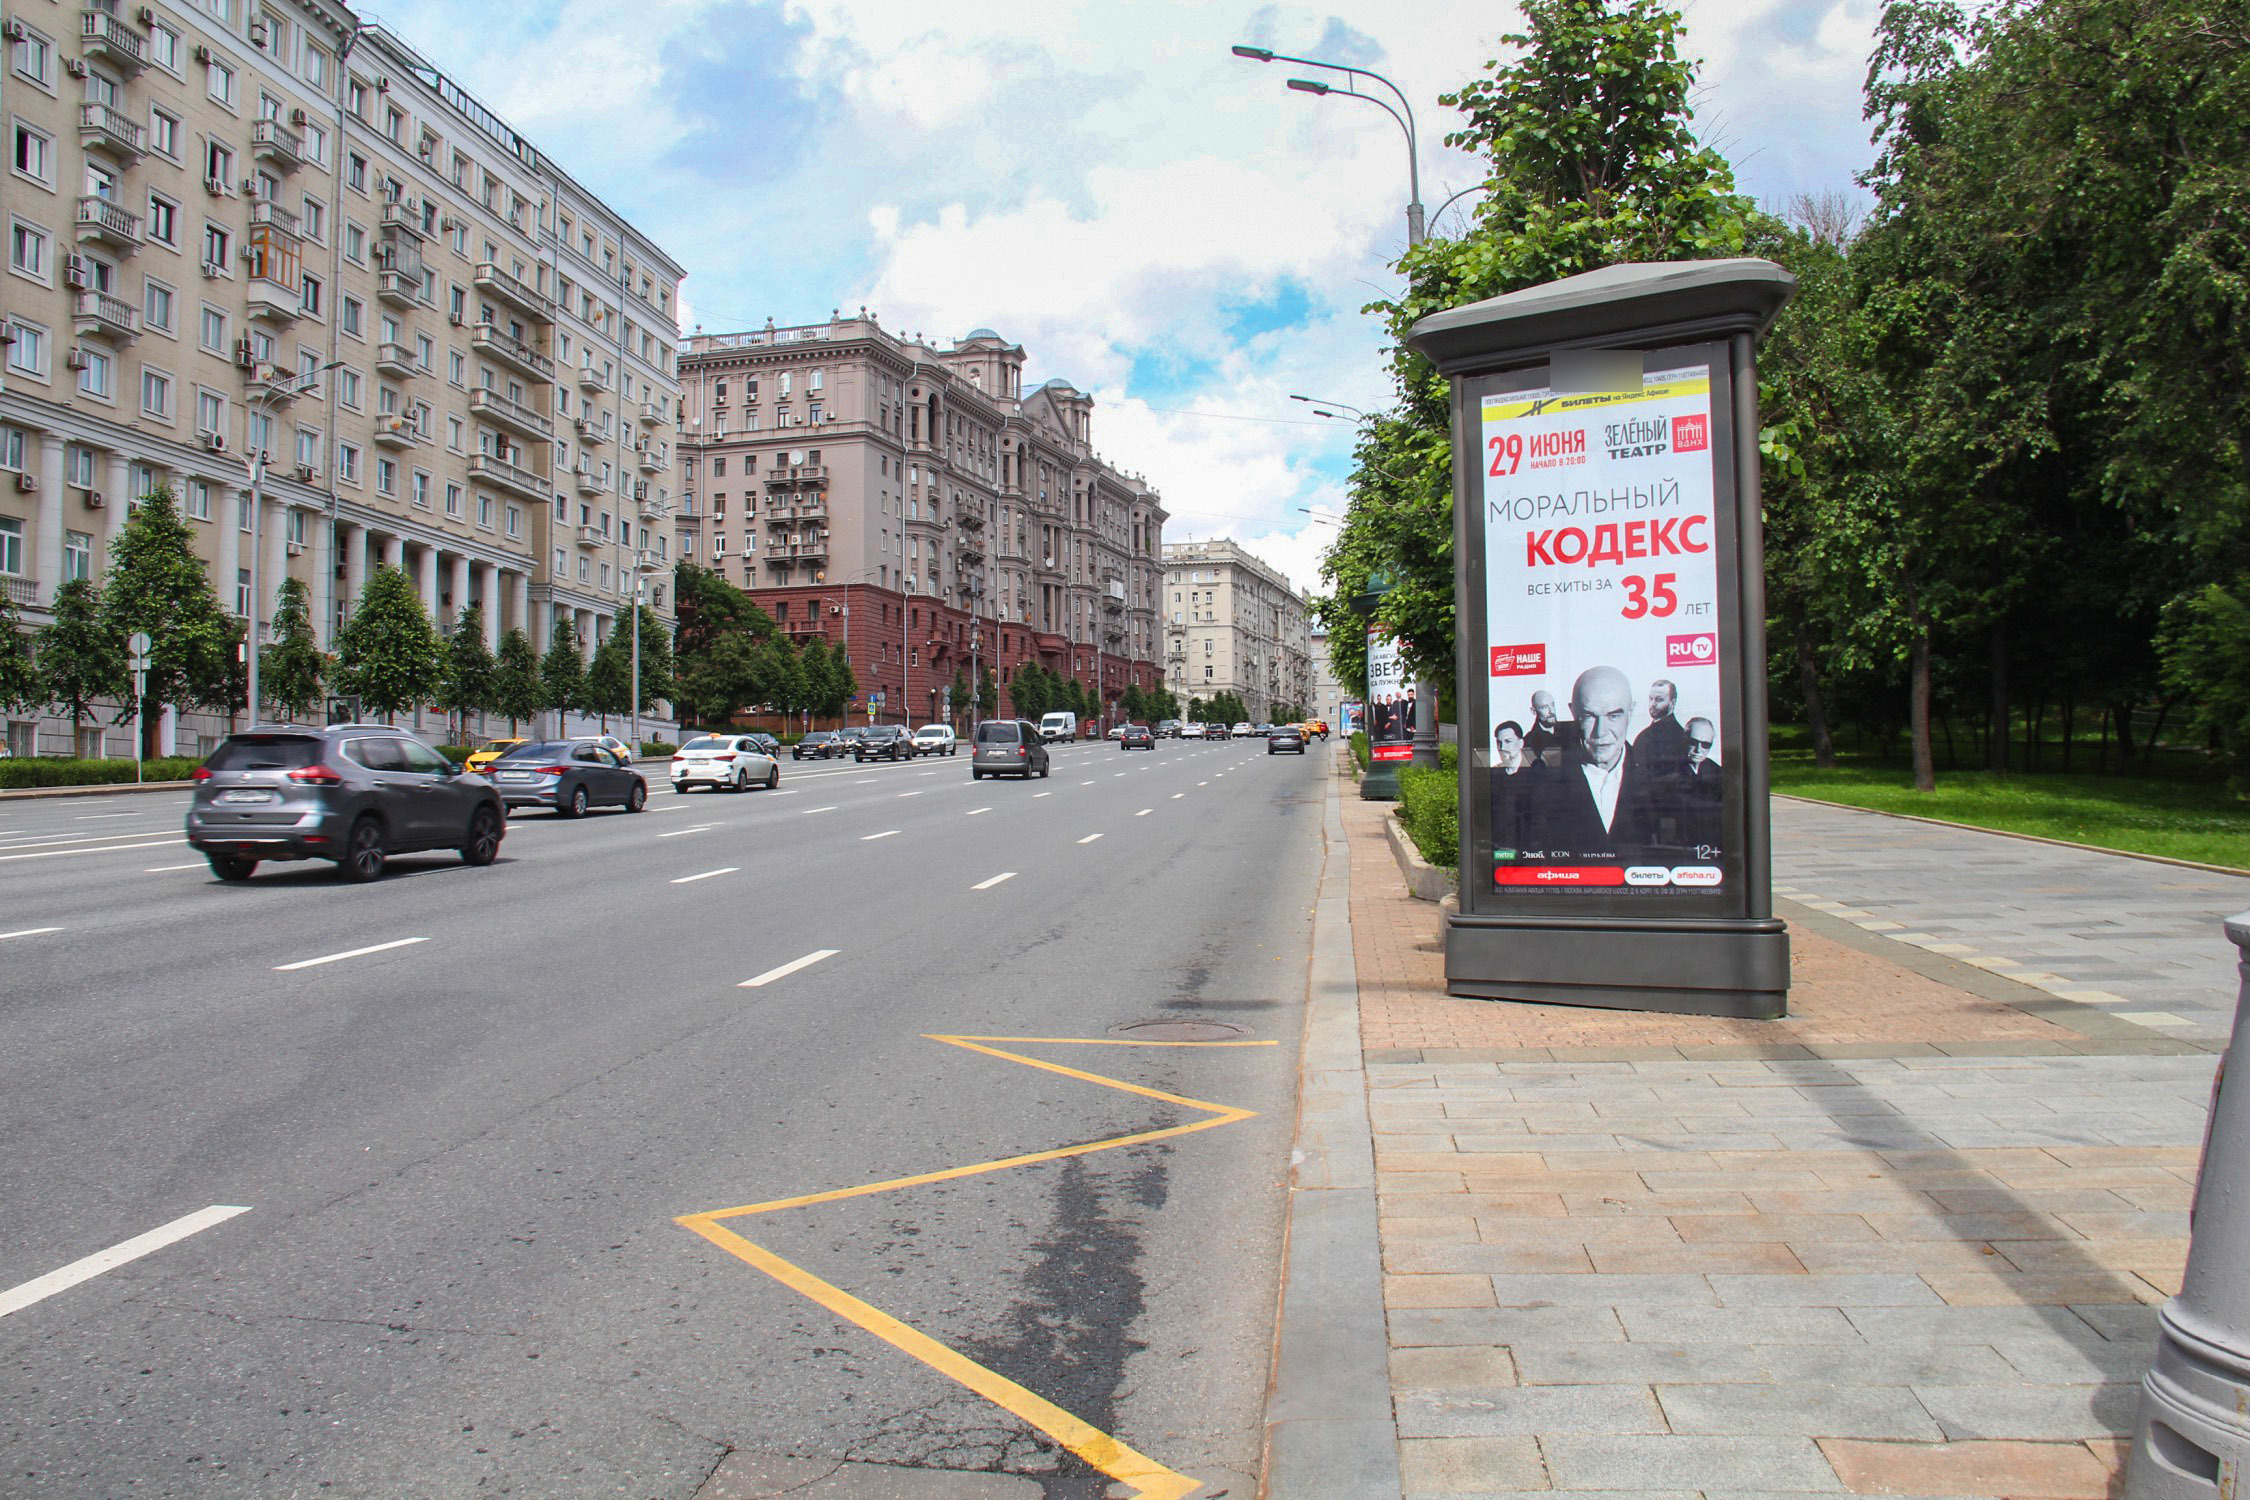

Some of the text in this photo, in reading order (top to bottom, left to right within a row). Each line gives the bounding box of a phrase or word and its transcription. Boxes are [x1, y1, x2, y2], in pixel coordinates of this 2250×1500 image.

[1561, 396, 1611, 408] БИЛЕТЫ
[1622, 391, 1645, 400] Яндекс
[1604, 415, 1667, 447] ЗЕЛЁНЫЙ
[1608, 443, 1667, 460] ТЕАТР
[1677, 439, 1704, 448] ВДНХ
[1488, 429, 1586, 477] 29 ИЮНЯ
[1530, 455, 1586, 469] НАЧАЛО В 20:00
[1490, 477, 1679, 523] МОРАЛЬНЫЙ
[1526, 514, 1709, 568] КОДЕКС
[1527, 572, 1711, 620] ВСЕ ХИТЫ ЗА 35 ЛЕТ
[1516, 652, 1543, 664] НАШЕ
[1370, 661, 1407, 678] ЗВЕР
[1495, 851, 1514, 859] metro
[1694, 844, 1722, 860] 12+
[1537, 871, 1580, 880] афиша
[1631, 871, 1664, 879] билеты
[1676, 871, 1716, 879] afisha.ru
